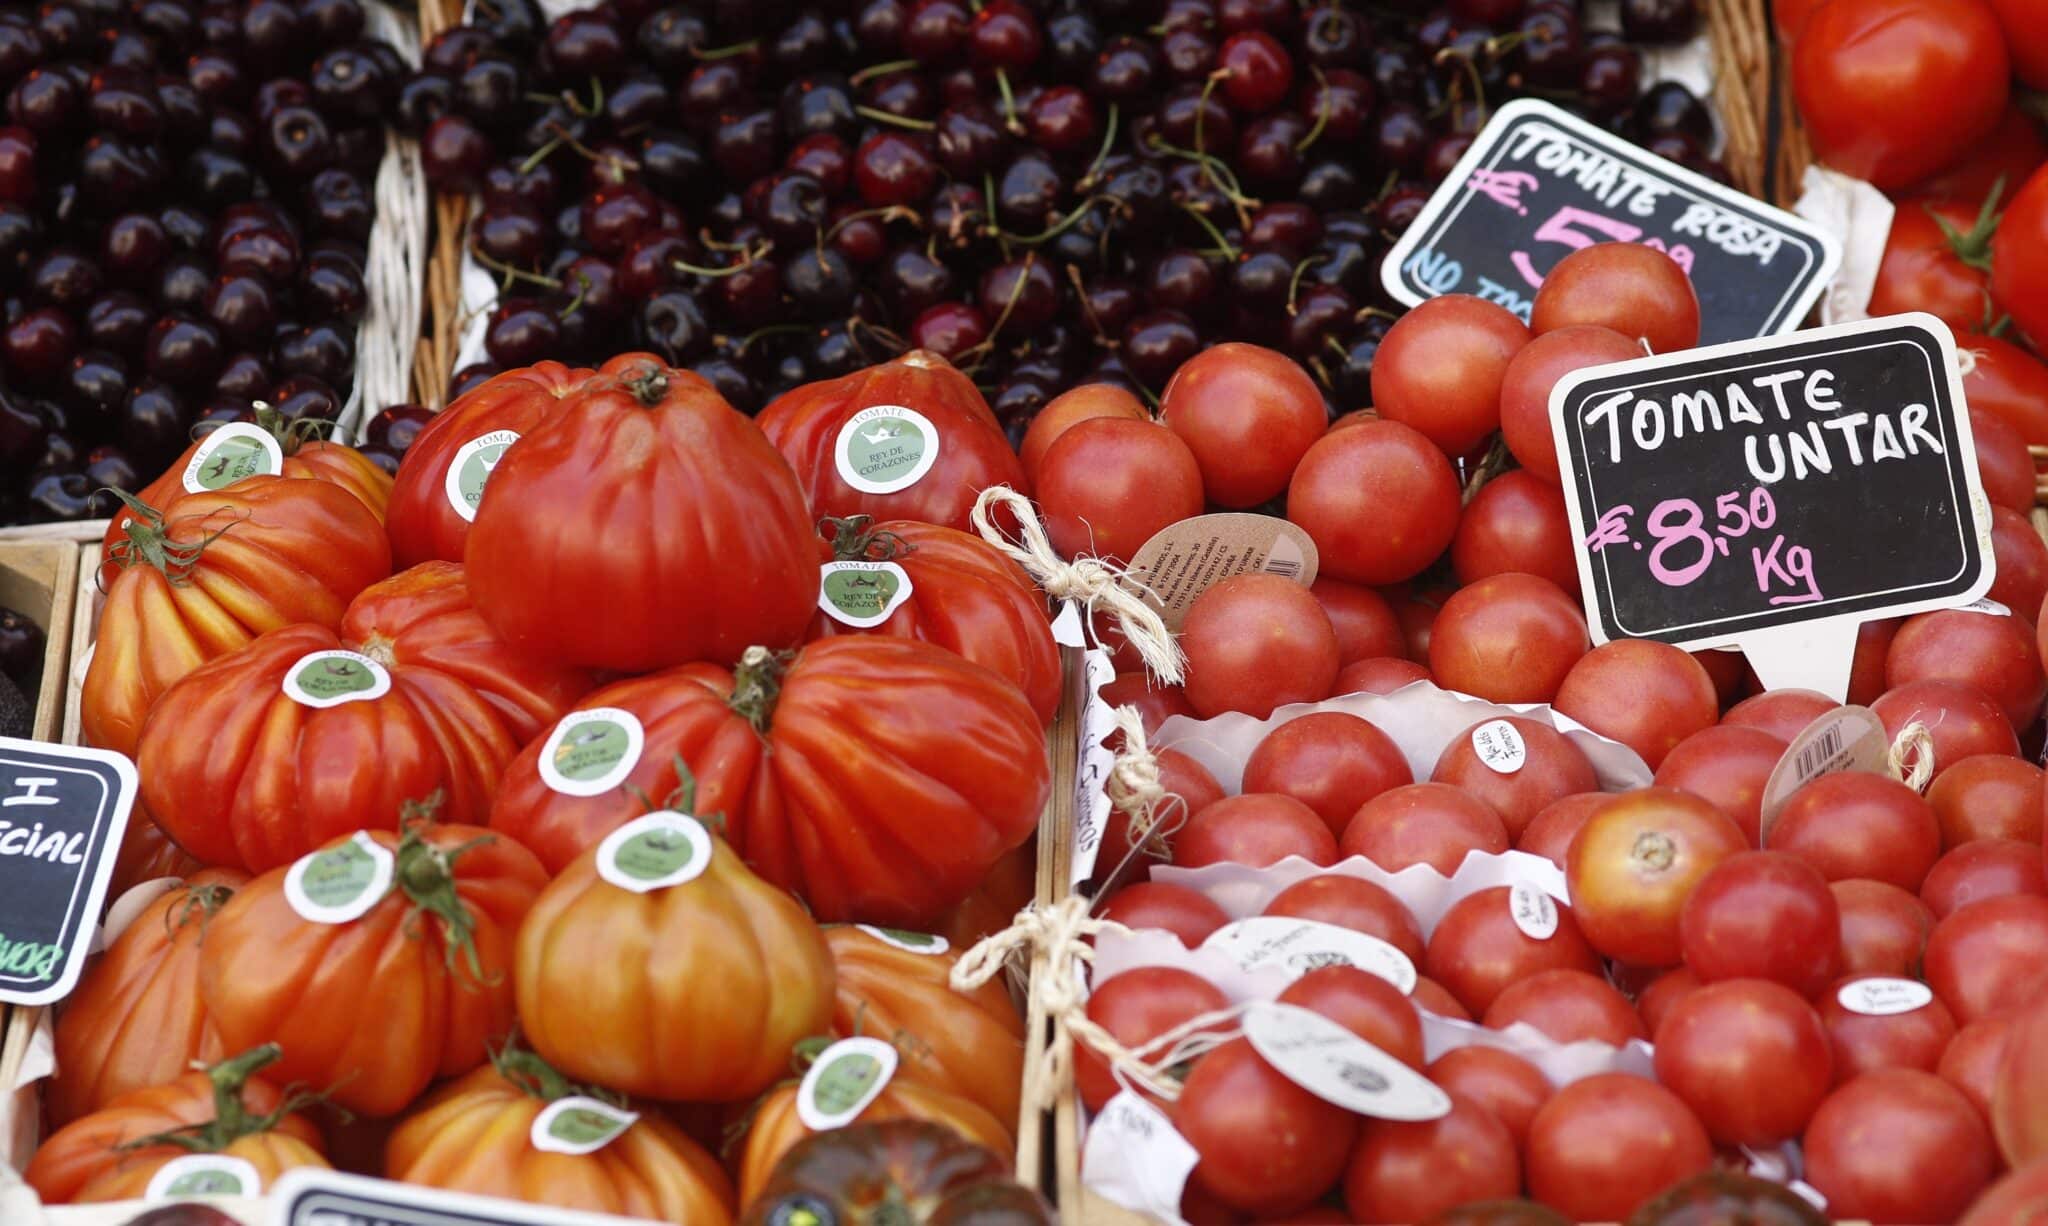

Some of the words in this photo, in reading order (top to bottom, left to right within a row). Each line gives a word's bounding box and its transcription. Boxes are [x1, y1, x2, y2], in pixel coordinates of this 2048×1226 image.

[1508, 125, 1672, 217] TOMATE
[1671, 201, 1784, 266] ROSA
[1402, 247, 1463, 294] NO
[852, 407, 904, 424] TOMATE
[1584, 367, 1838, 463] TOMATE
[1744, 402, 1944, 483] UNTAR
[860, 451, 921, 476] CORAZONES
[869, 450, 889, 463] REY
[889, 446, 904, 456] DE
[1751, 534, 1824, 606] Kg
